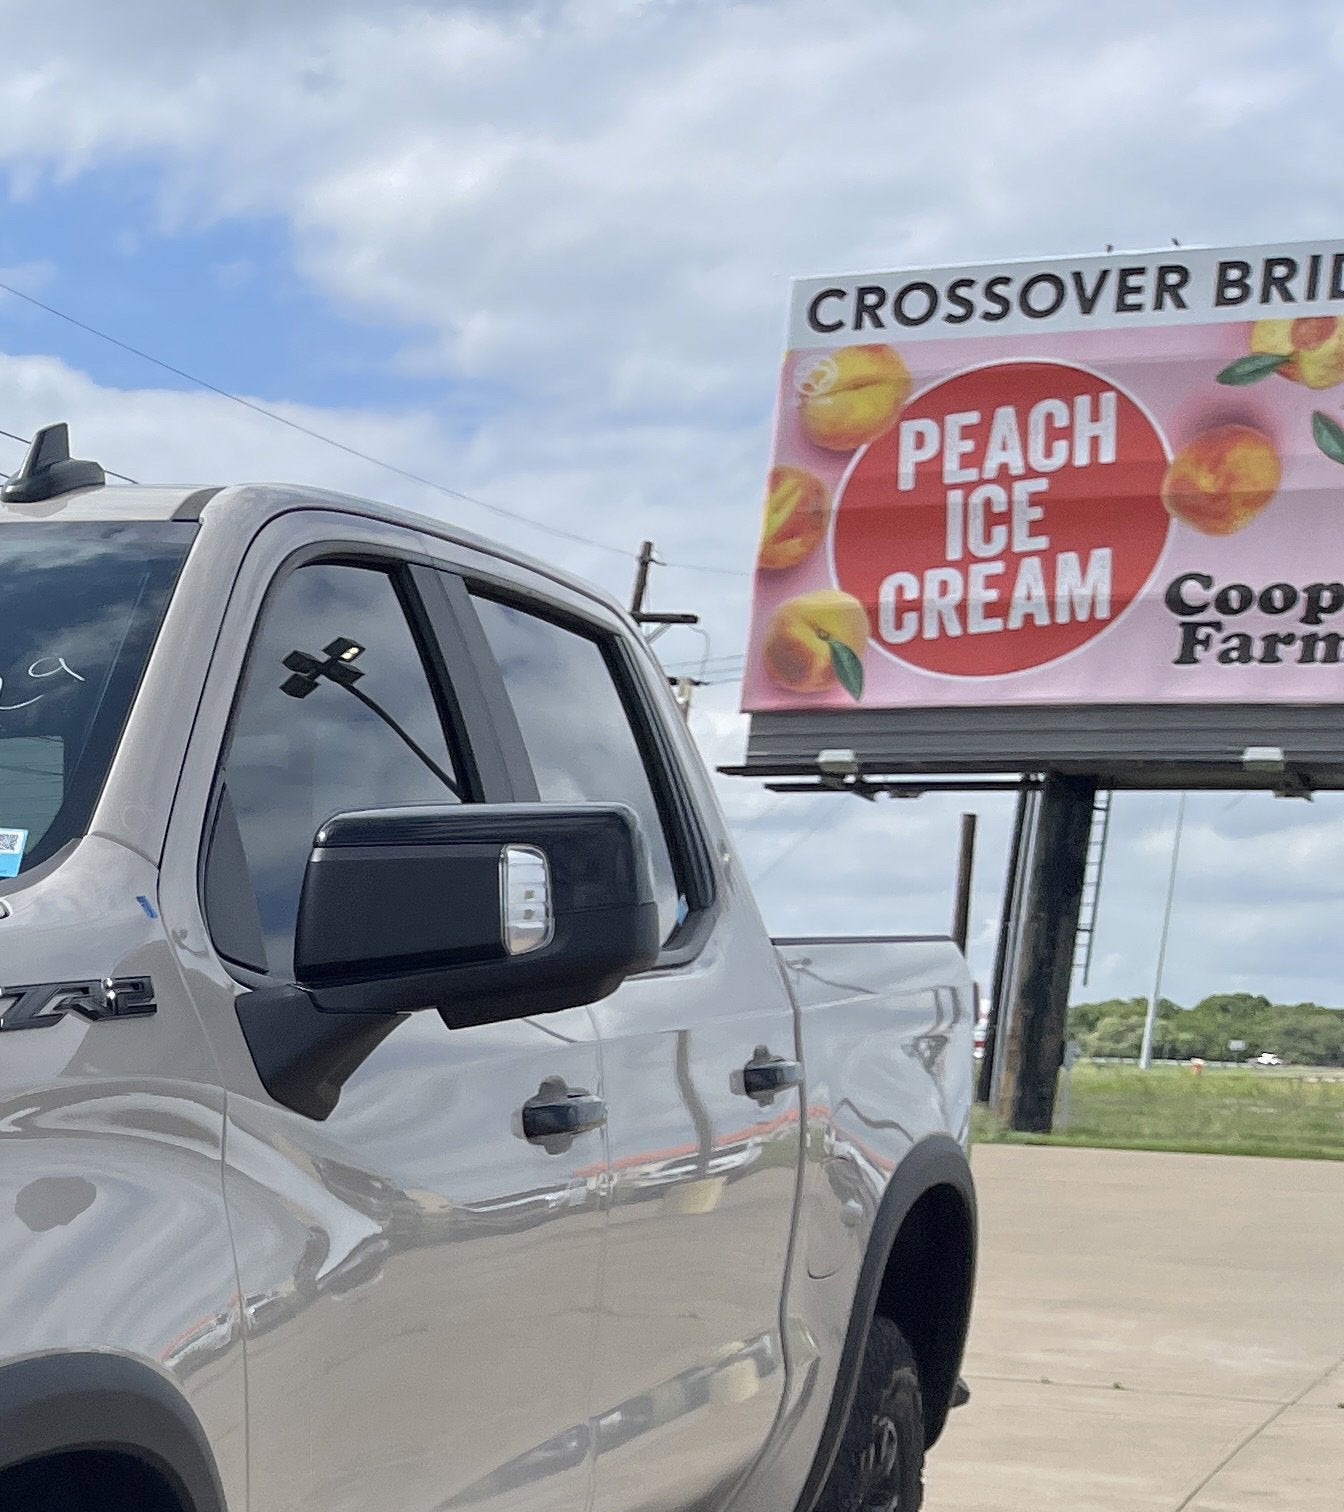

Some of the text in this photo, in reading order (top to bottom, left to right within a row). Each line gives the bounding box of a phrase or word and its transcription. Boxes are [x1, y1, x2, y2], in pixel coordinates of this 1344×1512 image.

[807, 263, 1192, 334] CROSSOVER
[897, 391, 1118, 491] PEACH
[944, 478, 1050, 562] ICE
[877, 546, 1112, 645] CREAM
[1165, 572, 1344, 626] Coop
